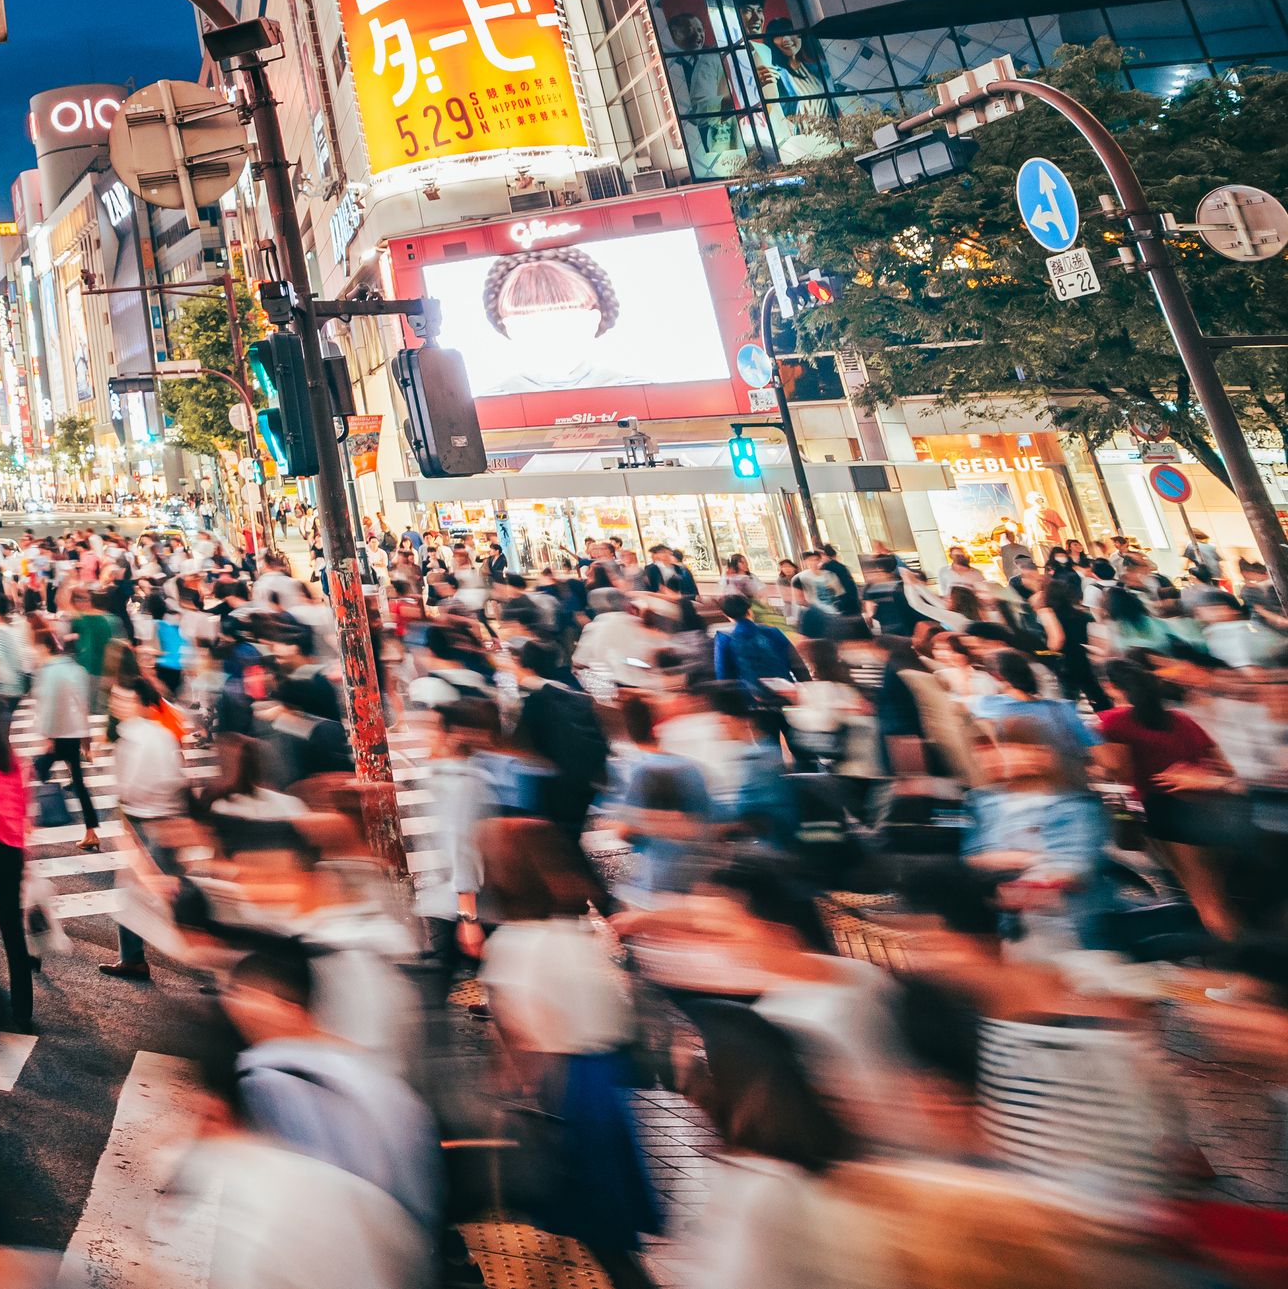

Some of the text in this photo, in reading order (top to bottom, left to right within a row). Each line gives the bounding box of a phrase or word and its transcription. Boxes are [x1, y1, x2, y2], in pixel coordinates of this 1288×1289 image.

[51, 98, 121, 132] OIO
[469, 91, 491, 135] SUN
[492, 98, 532, 115] NIPPON
[395, 97, 475, 158] 5.29
[499, 120, 512, 131] AT
